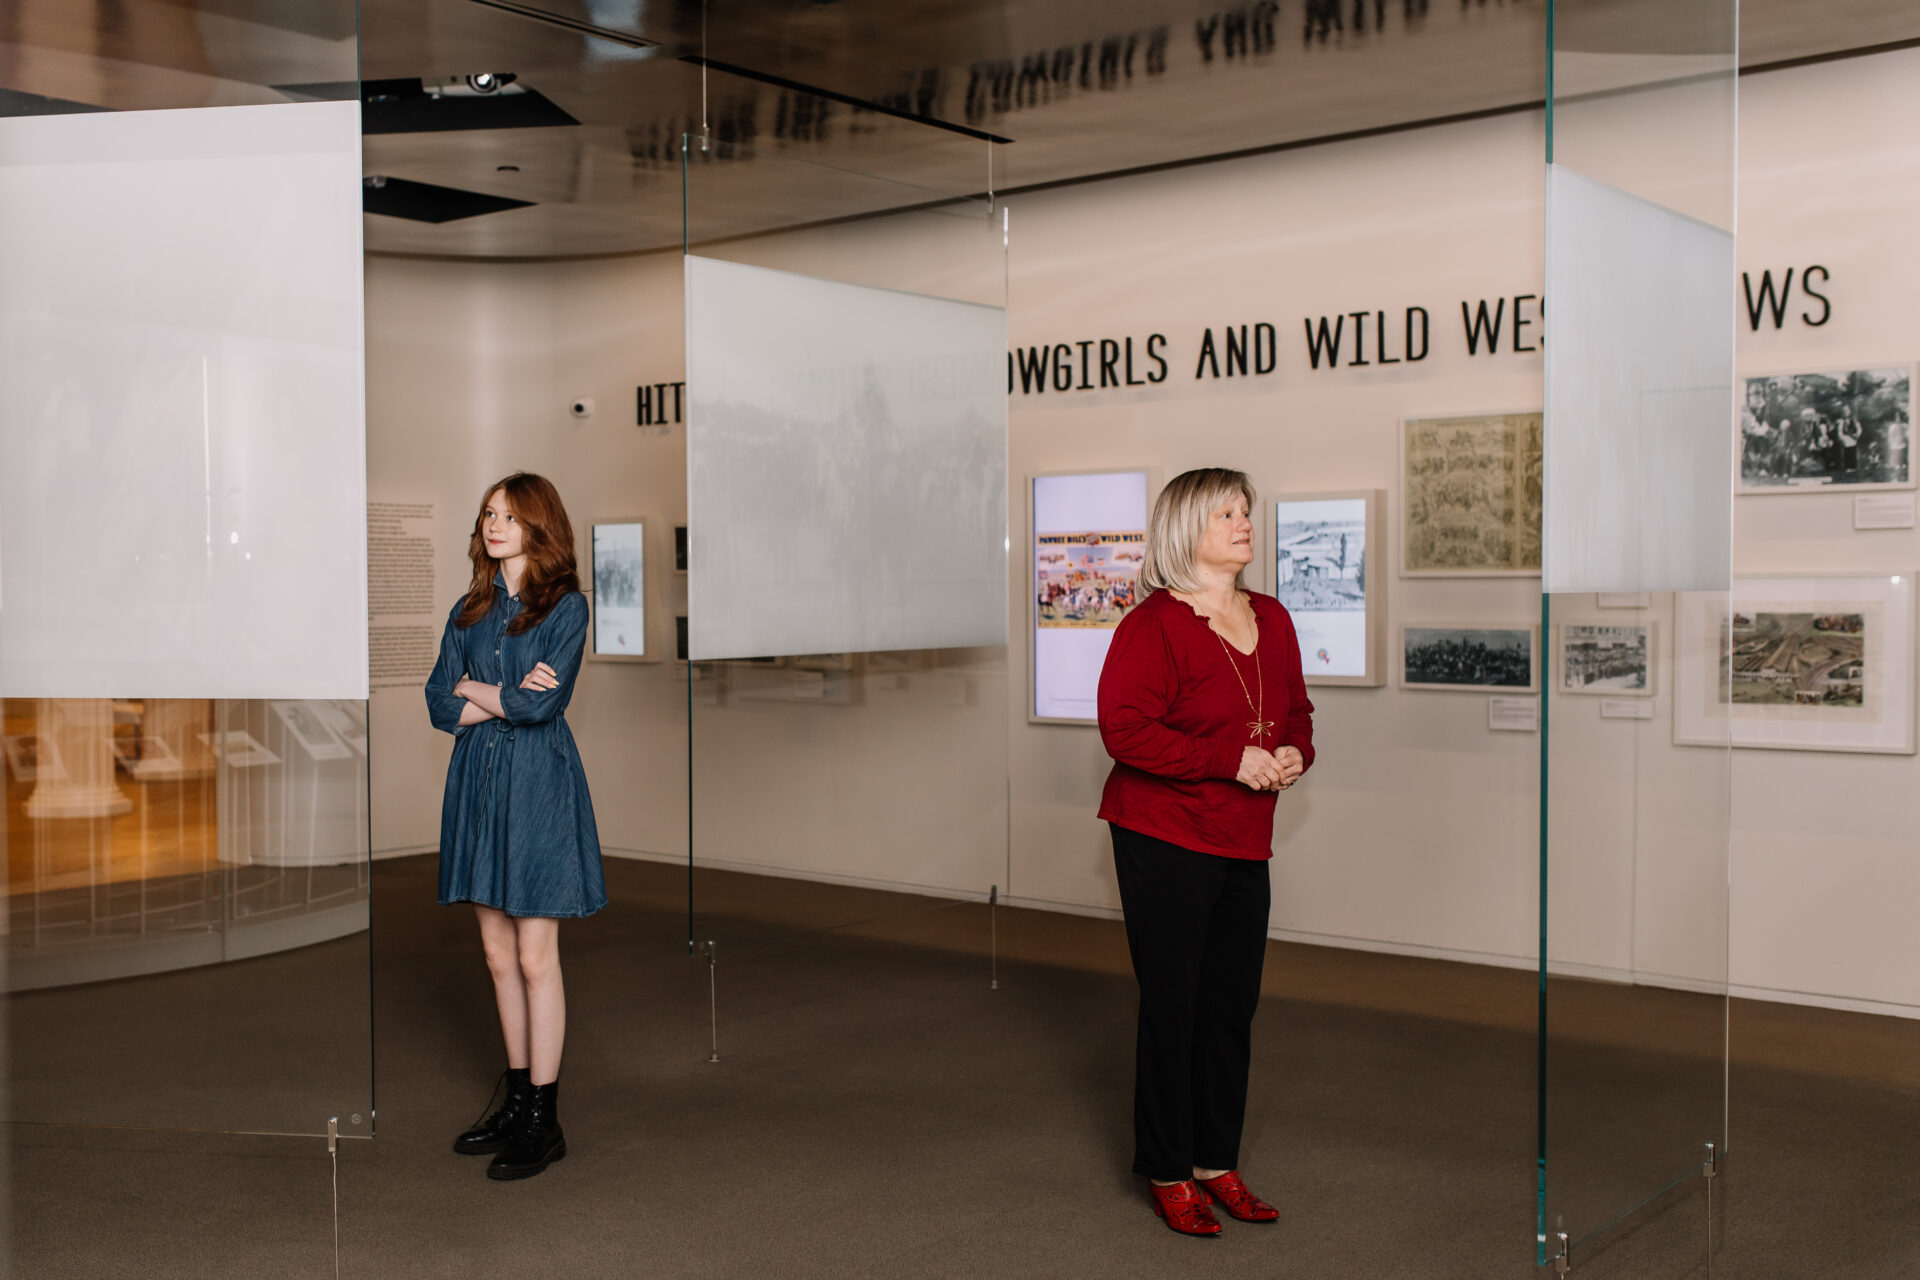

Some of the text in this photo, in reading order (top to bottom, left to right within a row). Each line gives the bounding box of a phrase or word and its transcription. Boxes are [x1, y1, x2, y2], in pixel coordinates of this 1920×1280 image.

[1195, 322, 1277, 380] AND
[1304, 306, 1431, 370] WILD
[1461, 294, 1545, 356] WE
[1100, 534, 1121, 543] WILD
